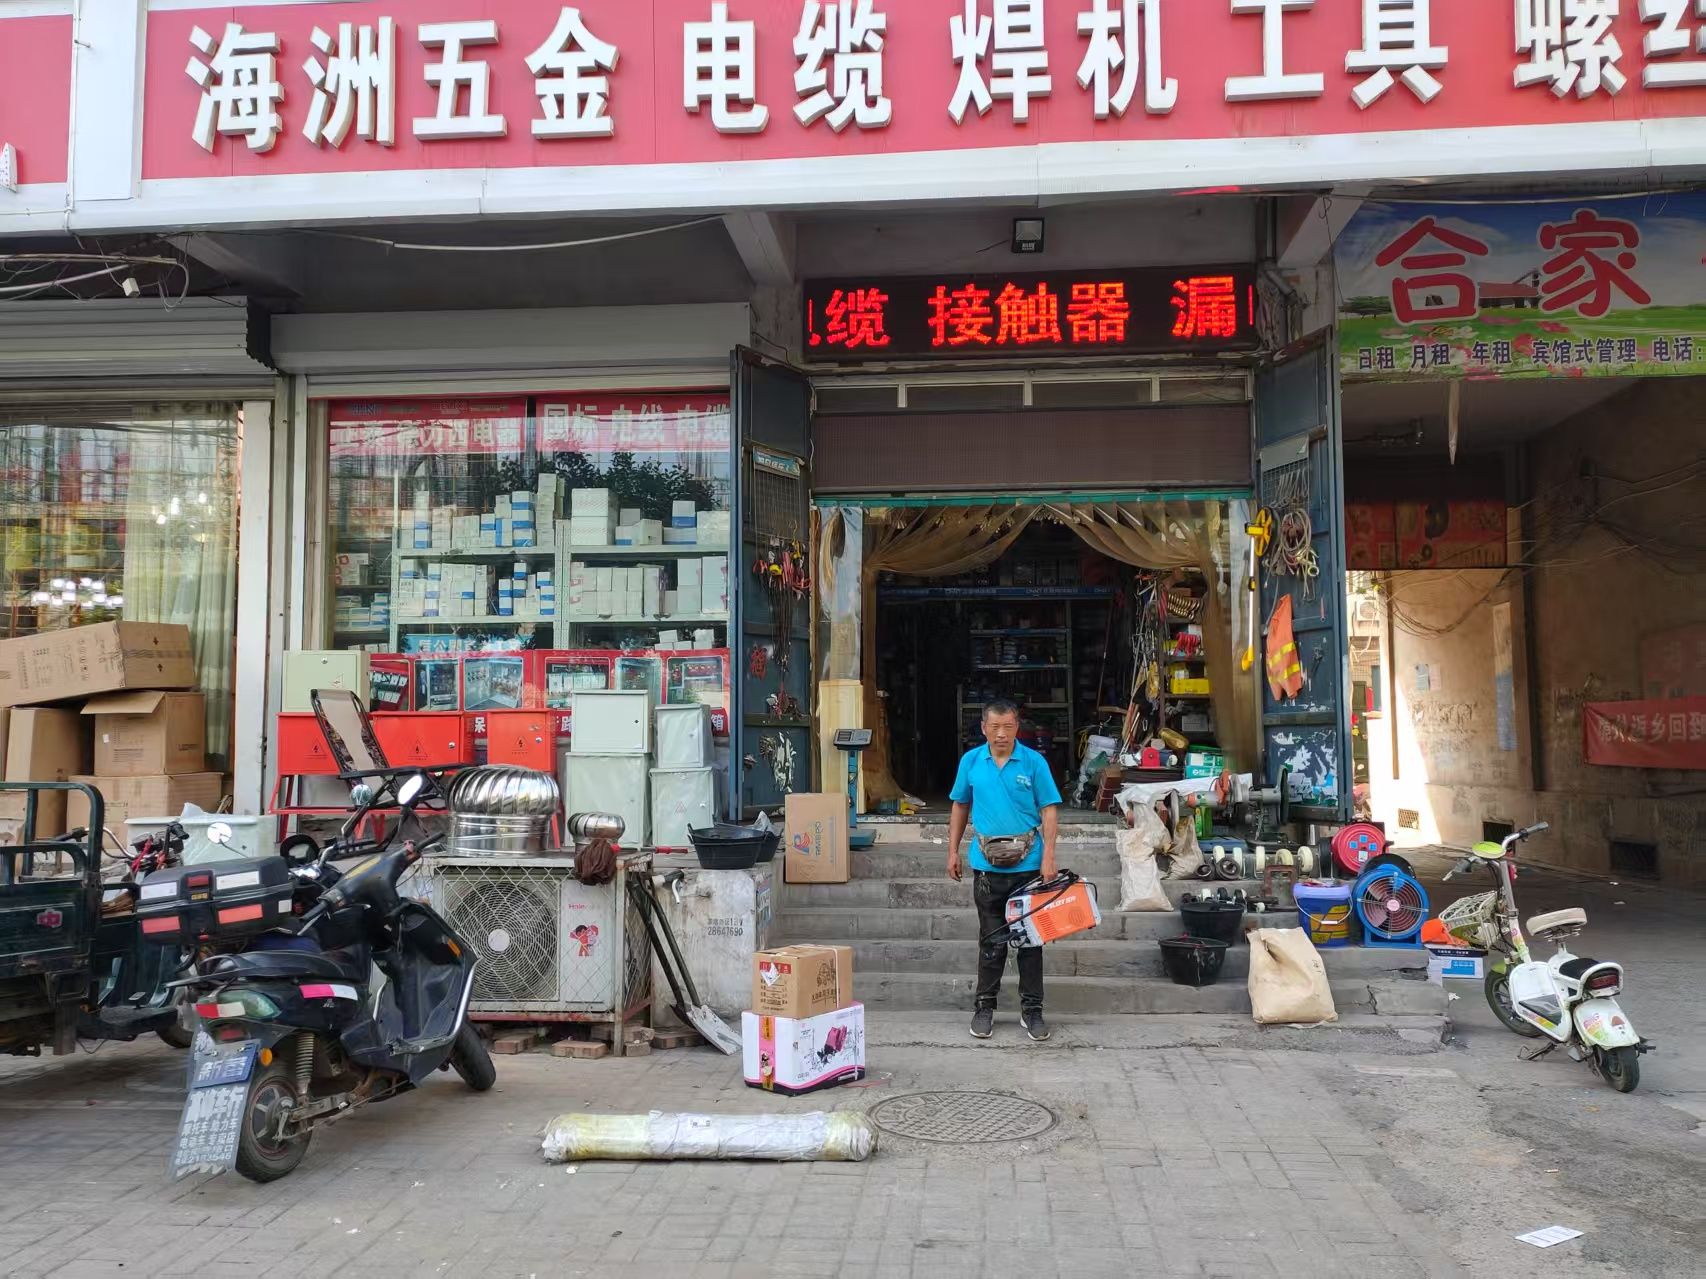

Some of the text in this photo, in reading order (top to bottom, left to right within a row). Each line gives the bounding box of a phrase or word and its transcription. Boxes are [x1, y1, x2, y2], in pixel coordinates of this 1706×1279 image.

[183, 6, 620, 154] 海洲五金
[682, 0, 892, 135] 电缆
[947, 0, 1178, 125] 焊机
[1224, 0, 1449, 111] 工具
[808, 275, 1253, 347] 缆 接触器 漏
[1375, 209, 1706, 323] 合家
[1358, 347, 1395, 370] 日租
[1410, 343, 1451, 368] 月租
[1471, 339, 1513, 365] 年租
[1531, 338, 1637, 364] 宾馆式管理
